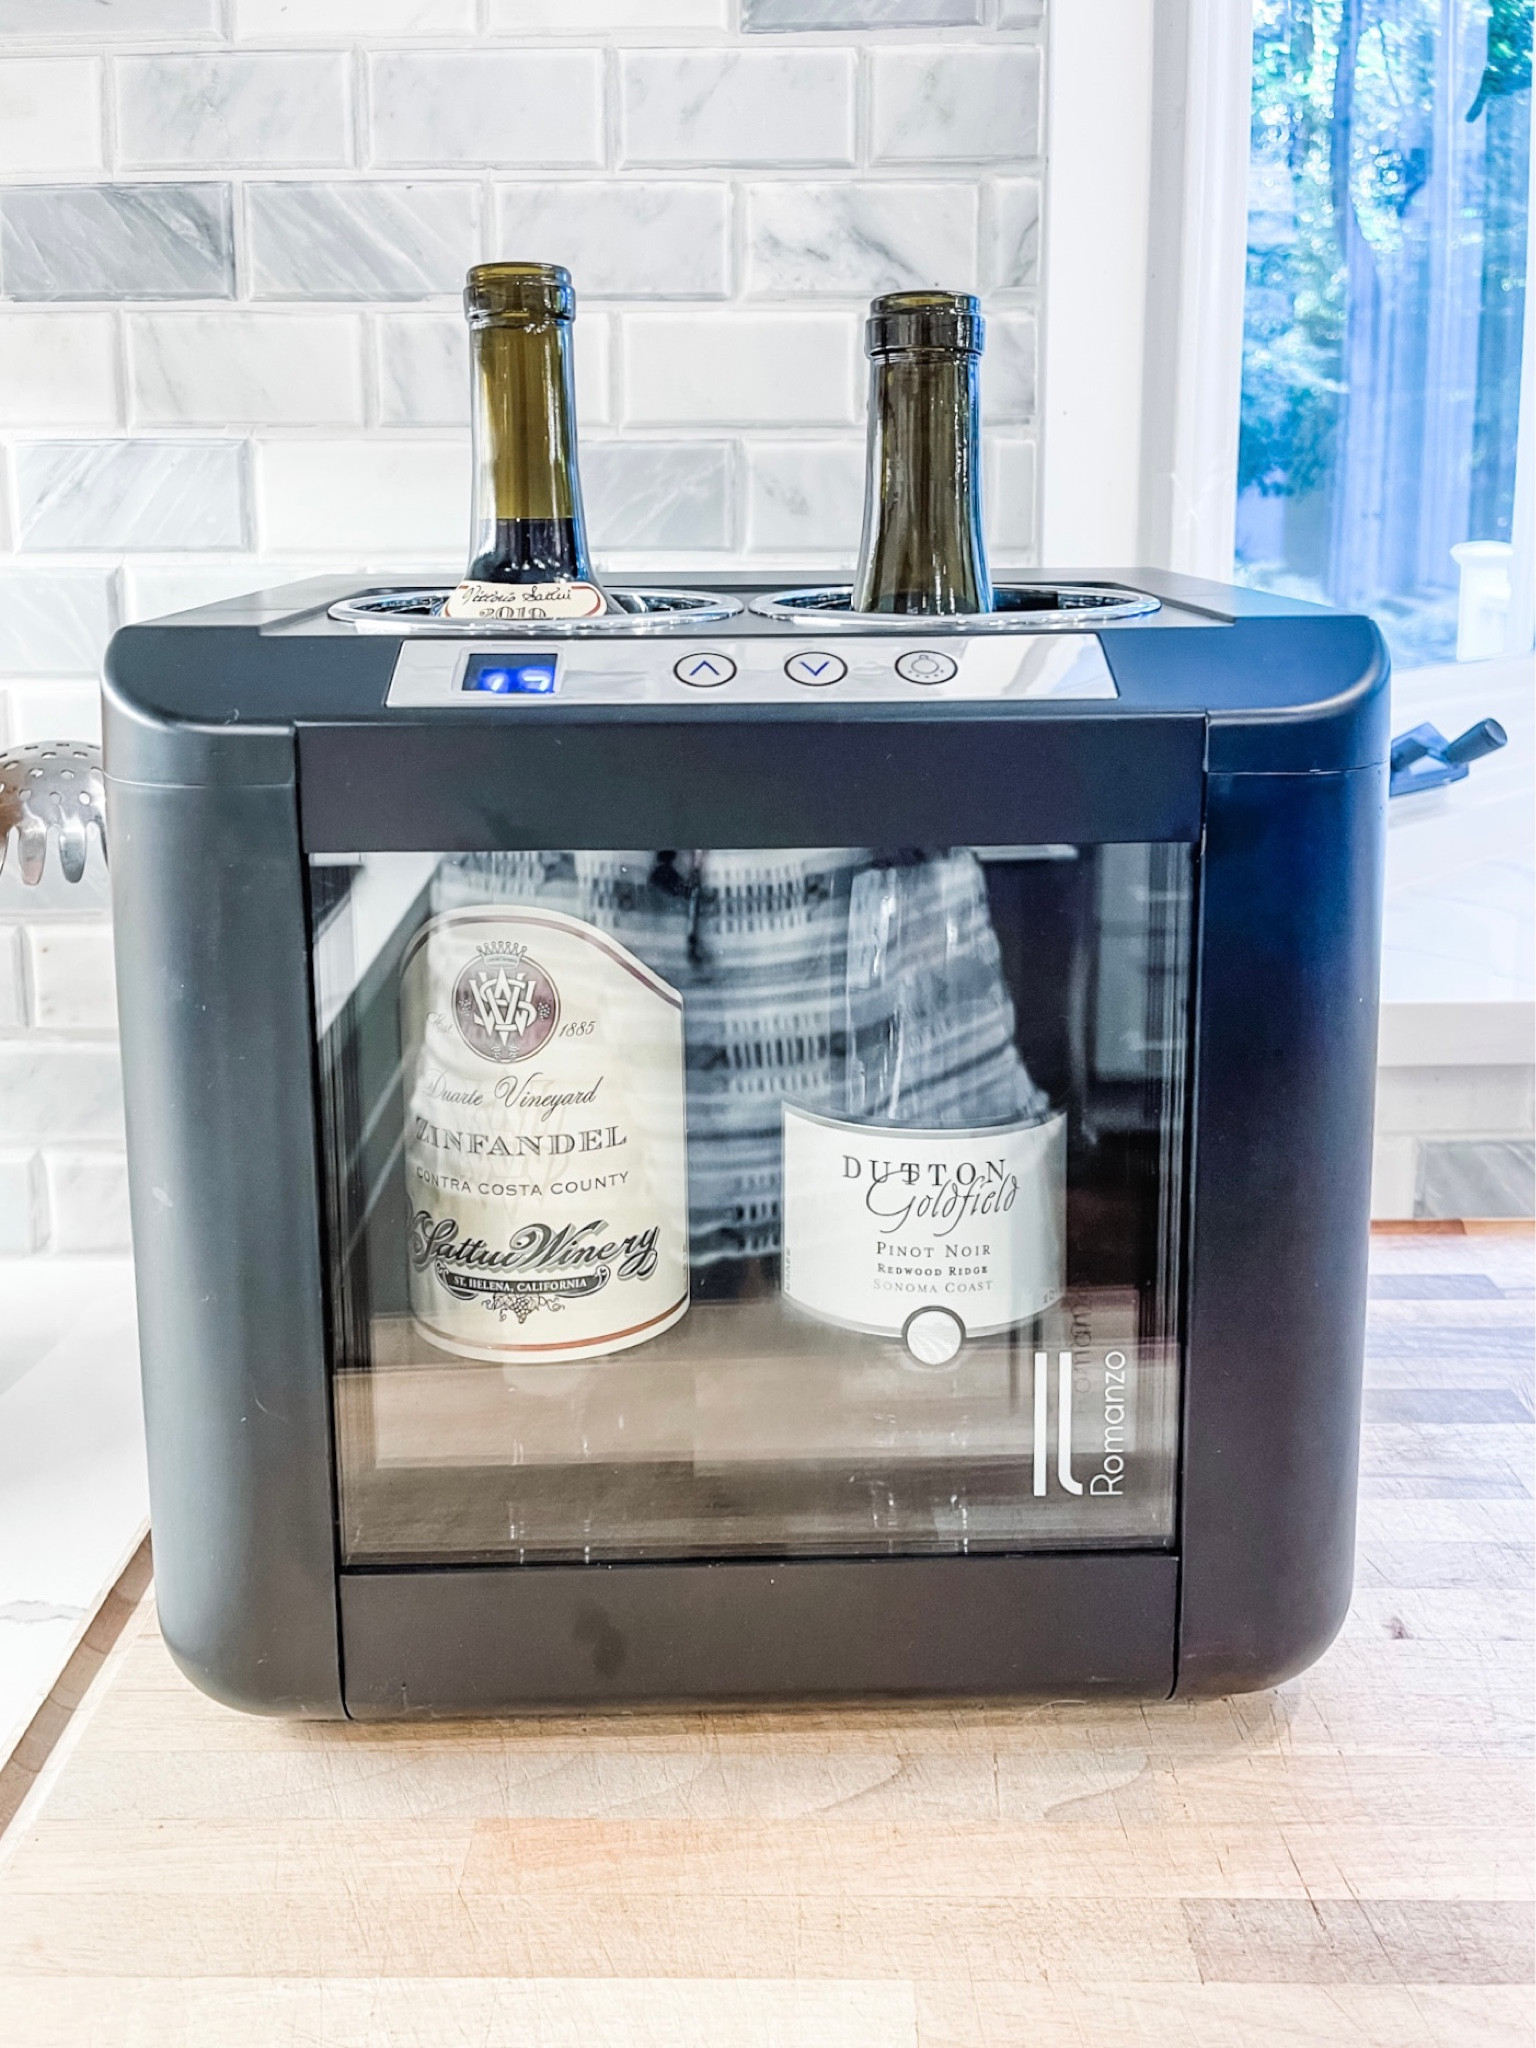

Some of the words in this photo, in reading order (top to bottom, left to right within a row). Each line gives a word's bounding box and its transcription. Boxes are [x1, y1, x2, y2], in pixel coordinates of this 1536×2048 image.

[559, 1020, 597, 1039] 1885
[424, 1068, 485, 1107] Duarte
[494, 1071, 605, 1123] Vineyard
[415, 1115, 628, 1157] ZINFANDEL
[416, 1166, 472, 1194] CONTRA
[478, 1182, 542, 1197] COSTA
[550, 1171, 630, 1195] COUNTY
[842, 1154, 1006, 1187] DUTTON
[865, 1170, 1020, 1238] Goldfield
[509, 1219, 662, 1282] Winery
[468, 1278, 514, 1293] HELENA,
[516, 1278, 588, 1293] CALIFORNIA
[1089, 1351, 1126, 1496] Romanzo
